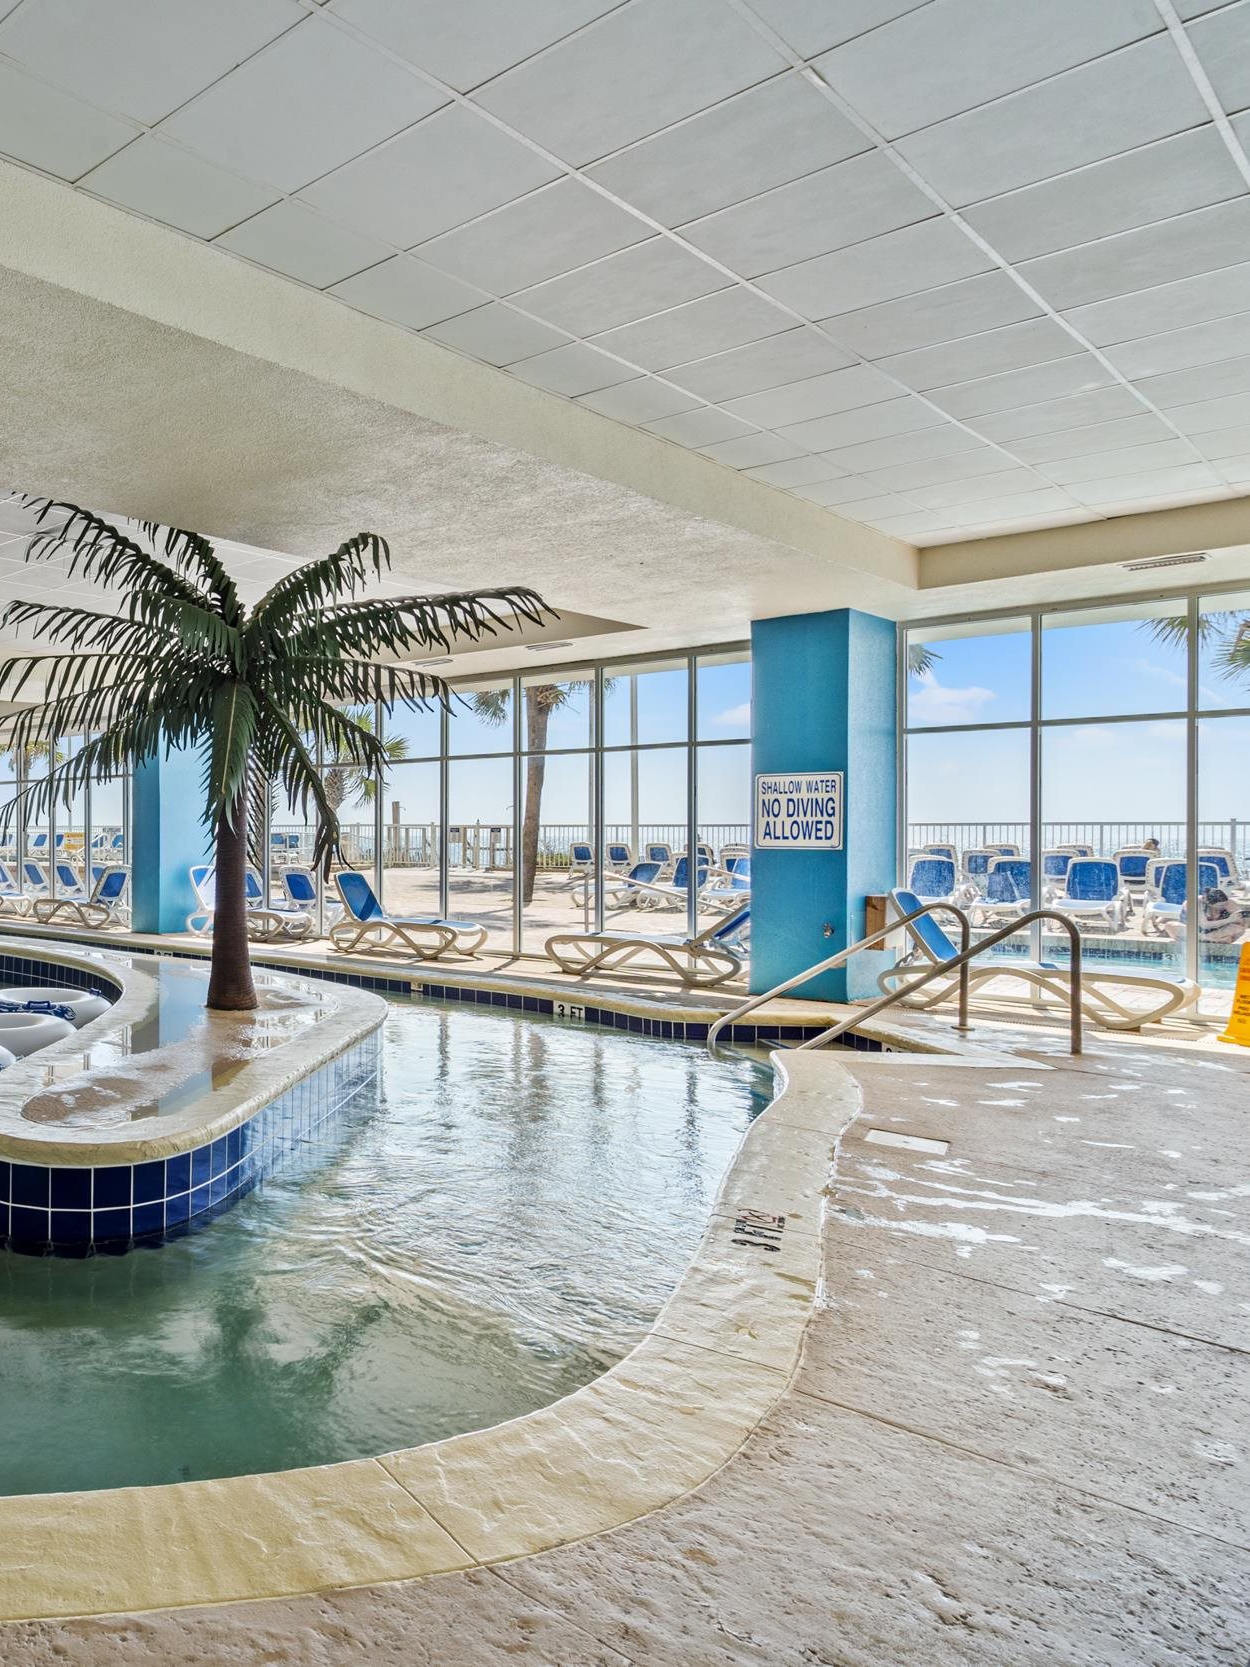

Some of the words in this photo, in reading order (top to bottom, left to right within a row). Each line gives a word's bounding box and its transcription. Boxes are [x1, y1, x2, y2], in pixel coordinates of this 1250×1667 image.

[761, 780, 803, 795] SHALLOW
[806, 779, 837, 794] WATER
[761, 798, 781, 818] NO
[786, 797, 836, 818] DIVING
[762, 820, 835, 841] ALLOWED
